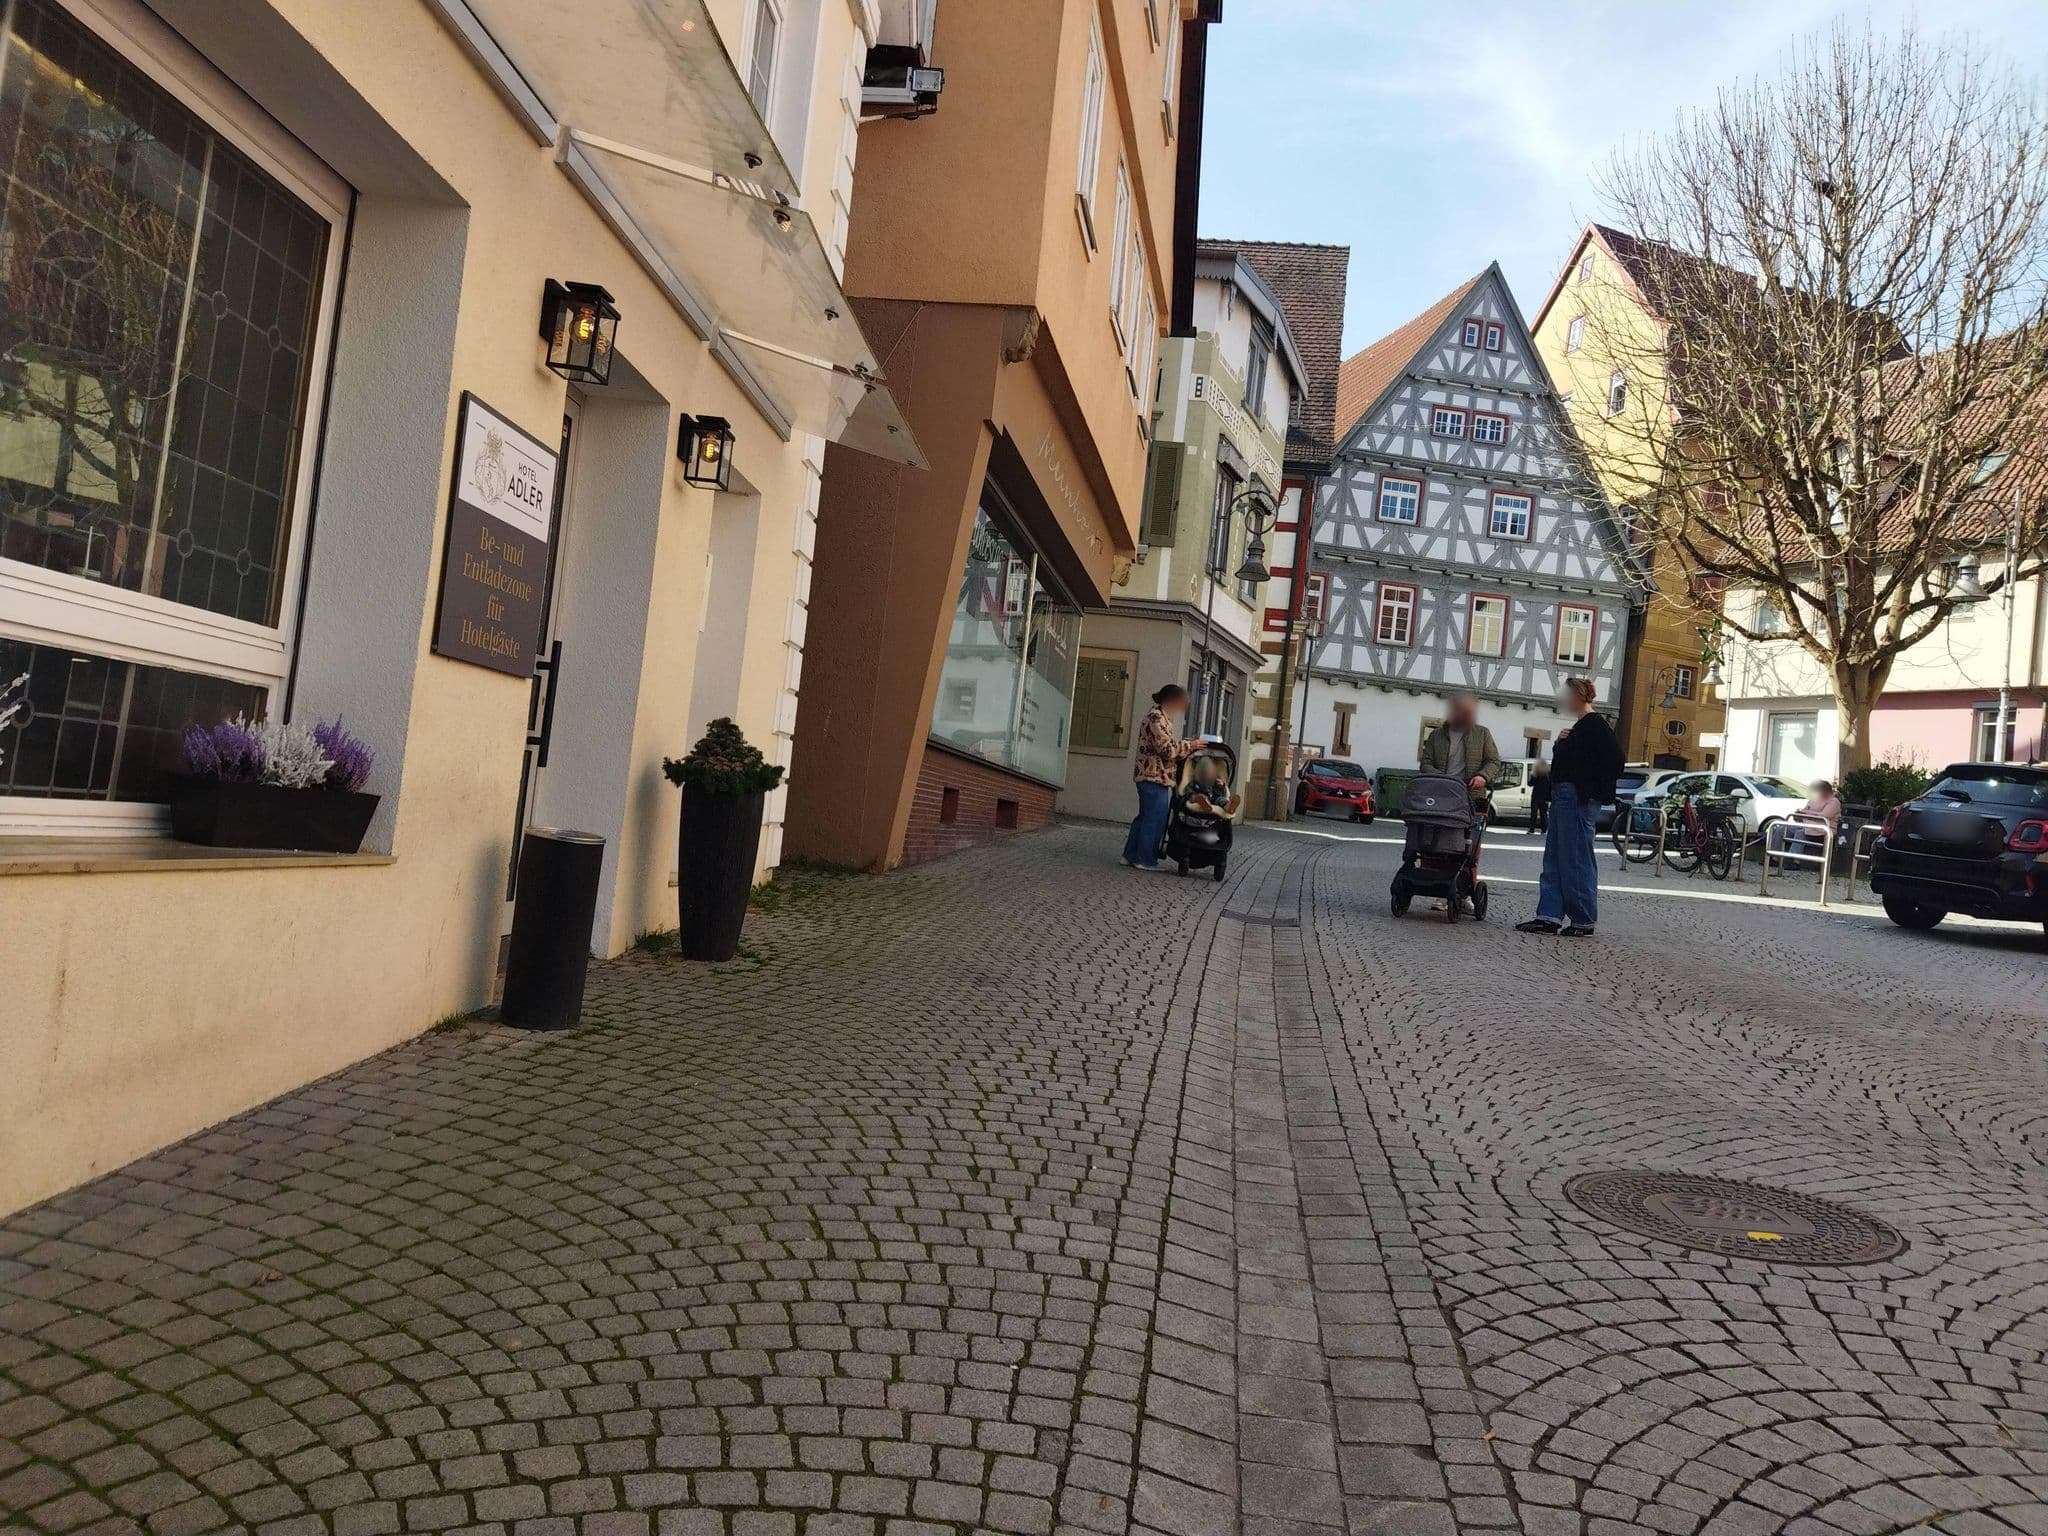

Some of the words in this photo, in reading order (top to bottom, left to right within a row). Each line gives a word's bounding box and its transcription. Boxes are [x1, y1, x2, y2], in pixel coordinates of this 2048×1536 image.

[518, 461, 538, 483] HOTEL
[507, 476, 544, 512] ADLER
[480, 527, 501, 553] Be-
[503, 543, 525, 568] und
[462, 552, 532, 602] Entladezone
[486, 593, 505, 621] für
[460, 619, 520, 660] Hotelgäste
